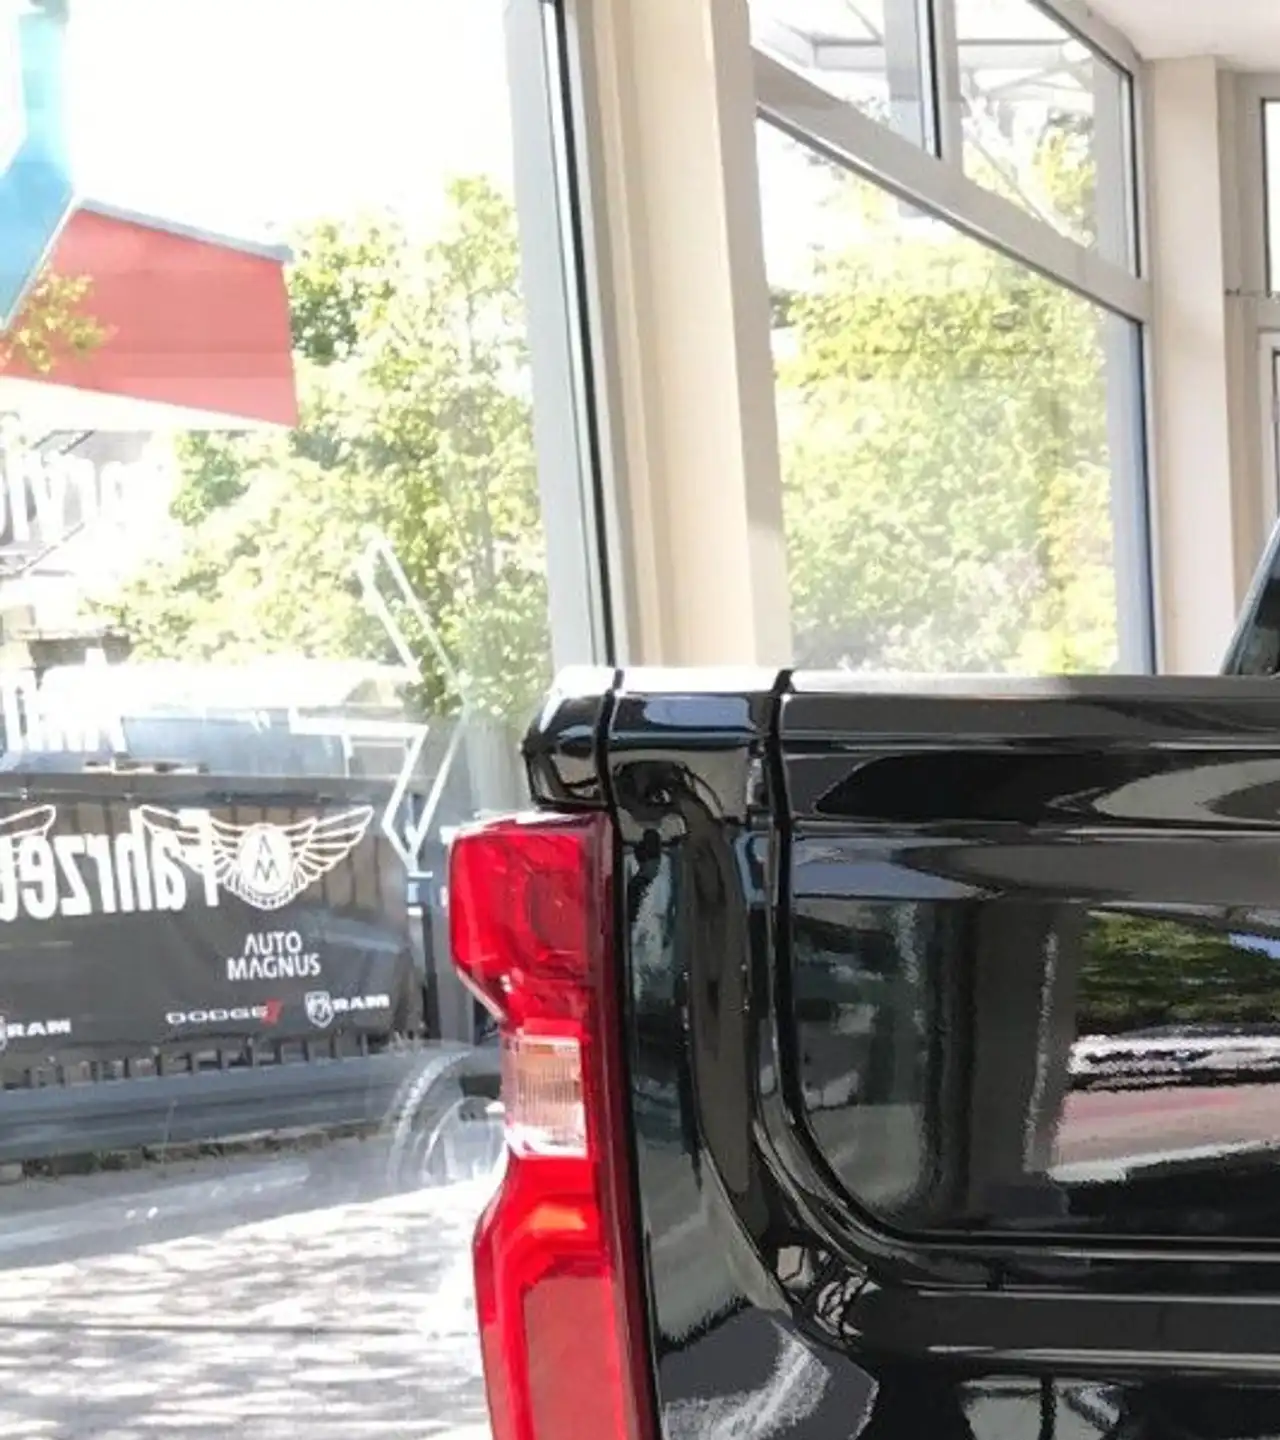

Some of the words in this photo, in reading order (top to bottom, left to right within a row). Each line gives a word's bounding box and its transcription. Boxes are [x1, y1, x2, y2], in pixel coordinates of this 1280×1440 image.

[244, 930, 303, 957] AUTO
[226, 952, 322, 982] MAGNUS
[331, 993, 391, 1012] RAM
[165, 1005, 268, 1025] DODGE
[6, 1018, 72, 1039] RAM
